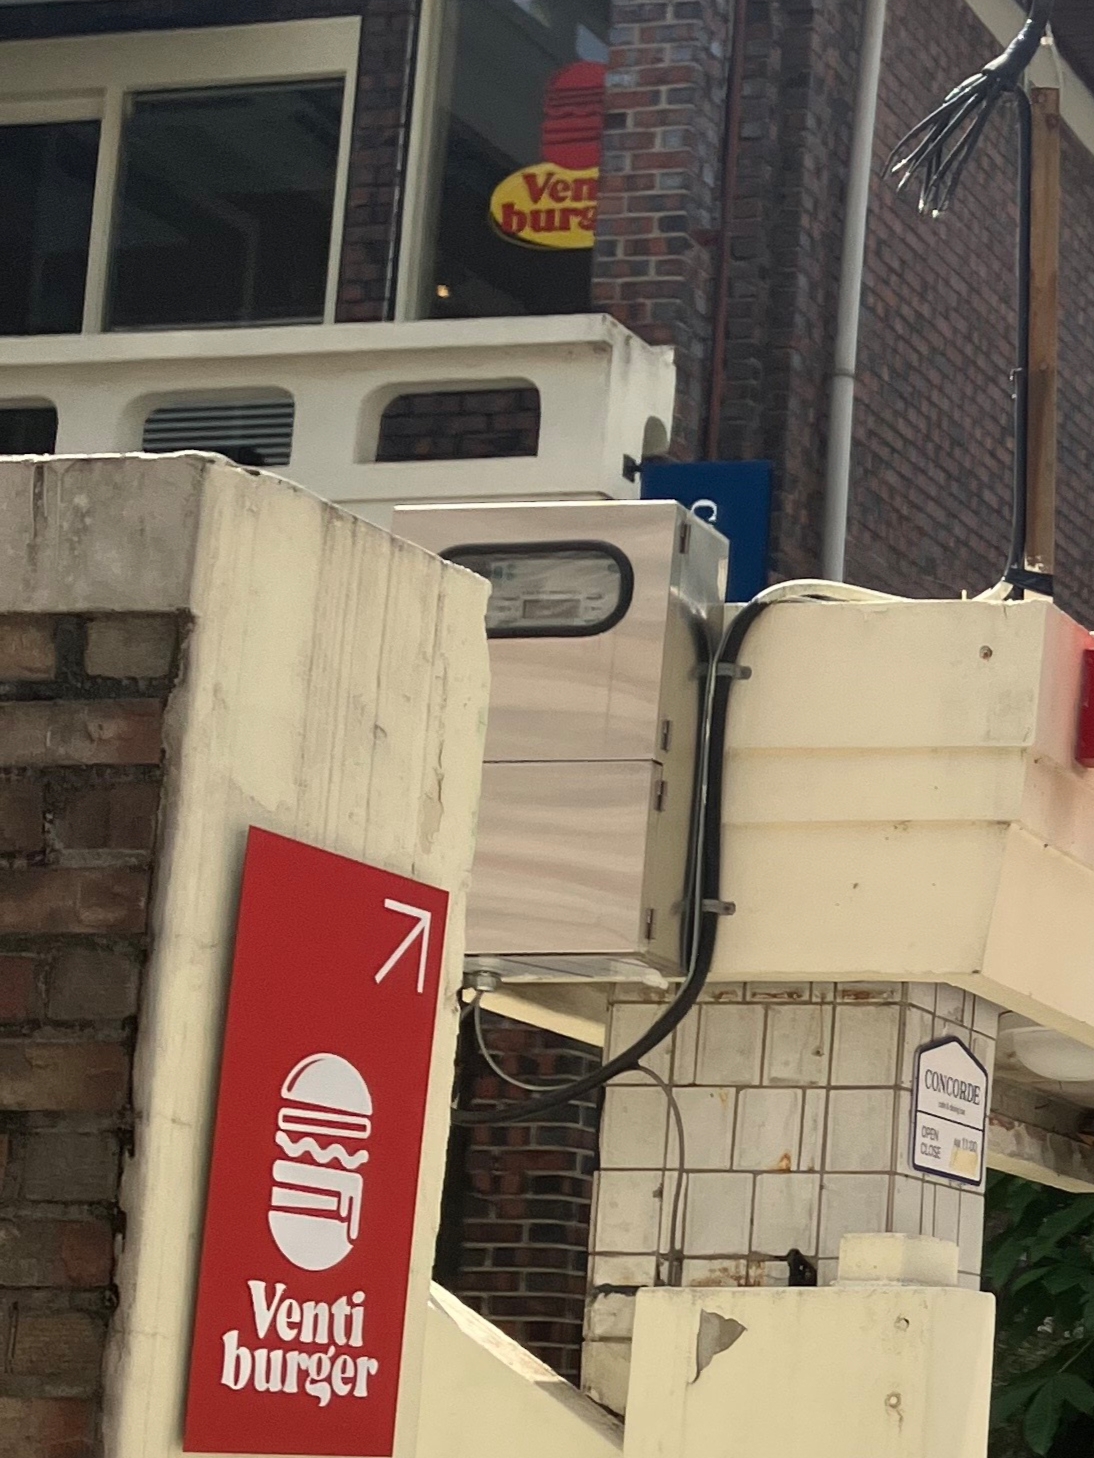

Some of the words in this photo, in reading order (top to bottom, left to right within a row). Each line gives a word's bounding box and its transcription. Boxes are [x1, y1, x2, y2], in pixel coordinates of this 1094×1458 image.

[522, 172, 597, 205] Ven
[501, 202, 596, 234] burg
[924, 1068, 981, 1106] CONCORDE
[921, 1125, 939, 1141] OPEN
[920, 1141, 941, 1160] CLOSE
[247, 1279, 366, 1348] Venti
[220, 1329, 379, 1408] burger
